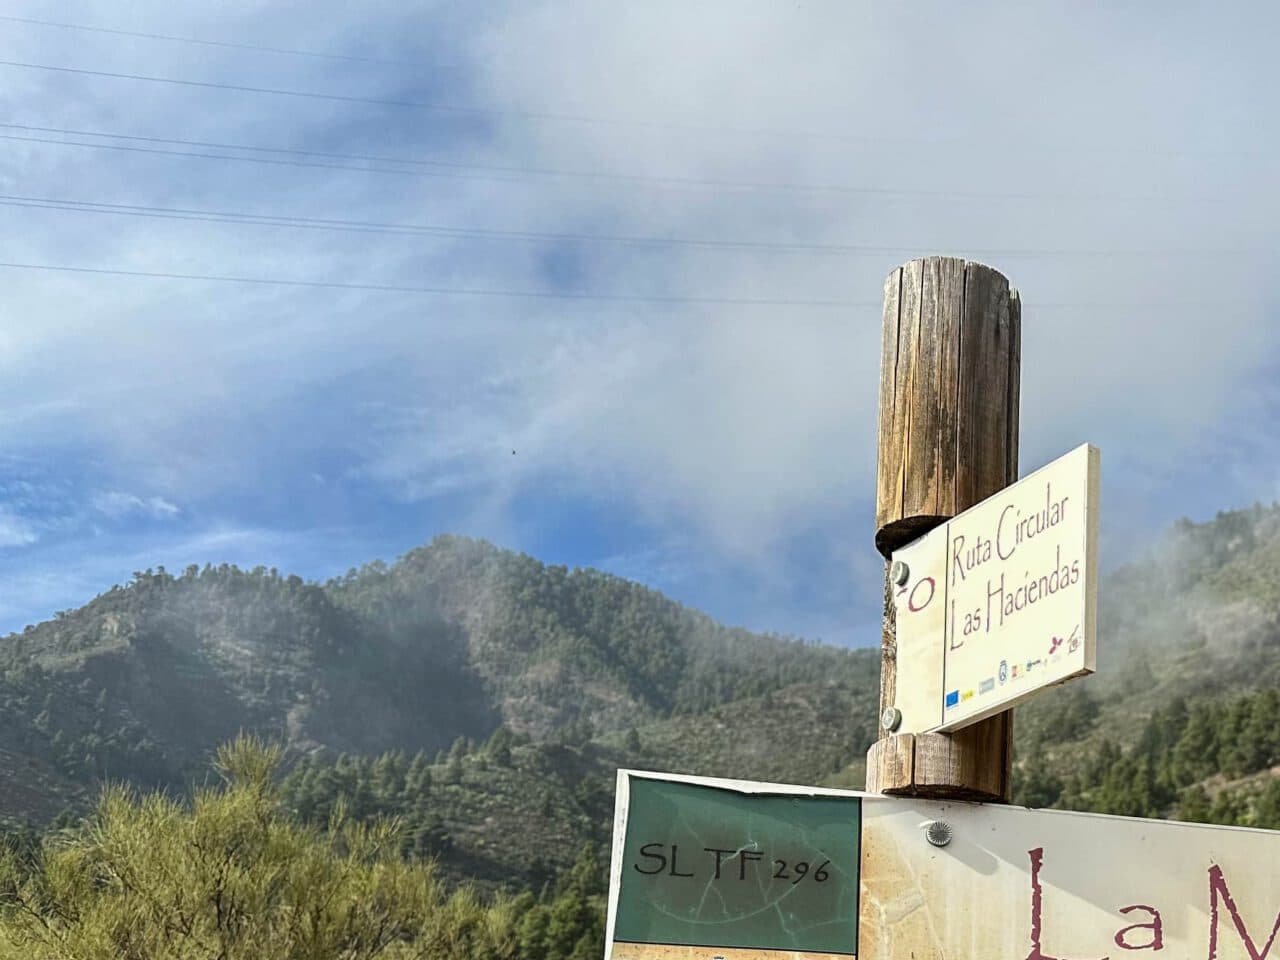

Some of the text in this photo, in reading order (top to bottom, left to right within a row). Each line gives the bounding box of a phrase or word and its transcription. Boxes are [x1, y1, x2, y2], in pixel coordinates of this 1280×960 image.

[951, 481, 1069, 587] Ruta Circular
[950, 543, 1080, 651] Las Haciendas
[633, 842, 832, 885] SL TF 296
